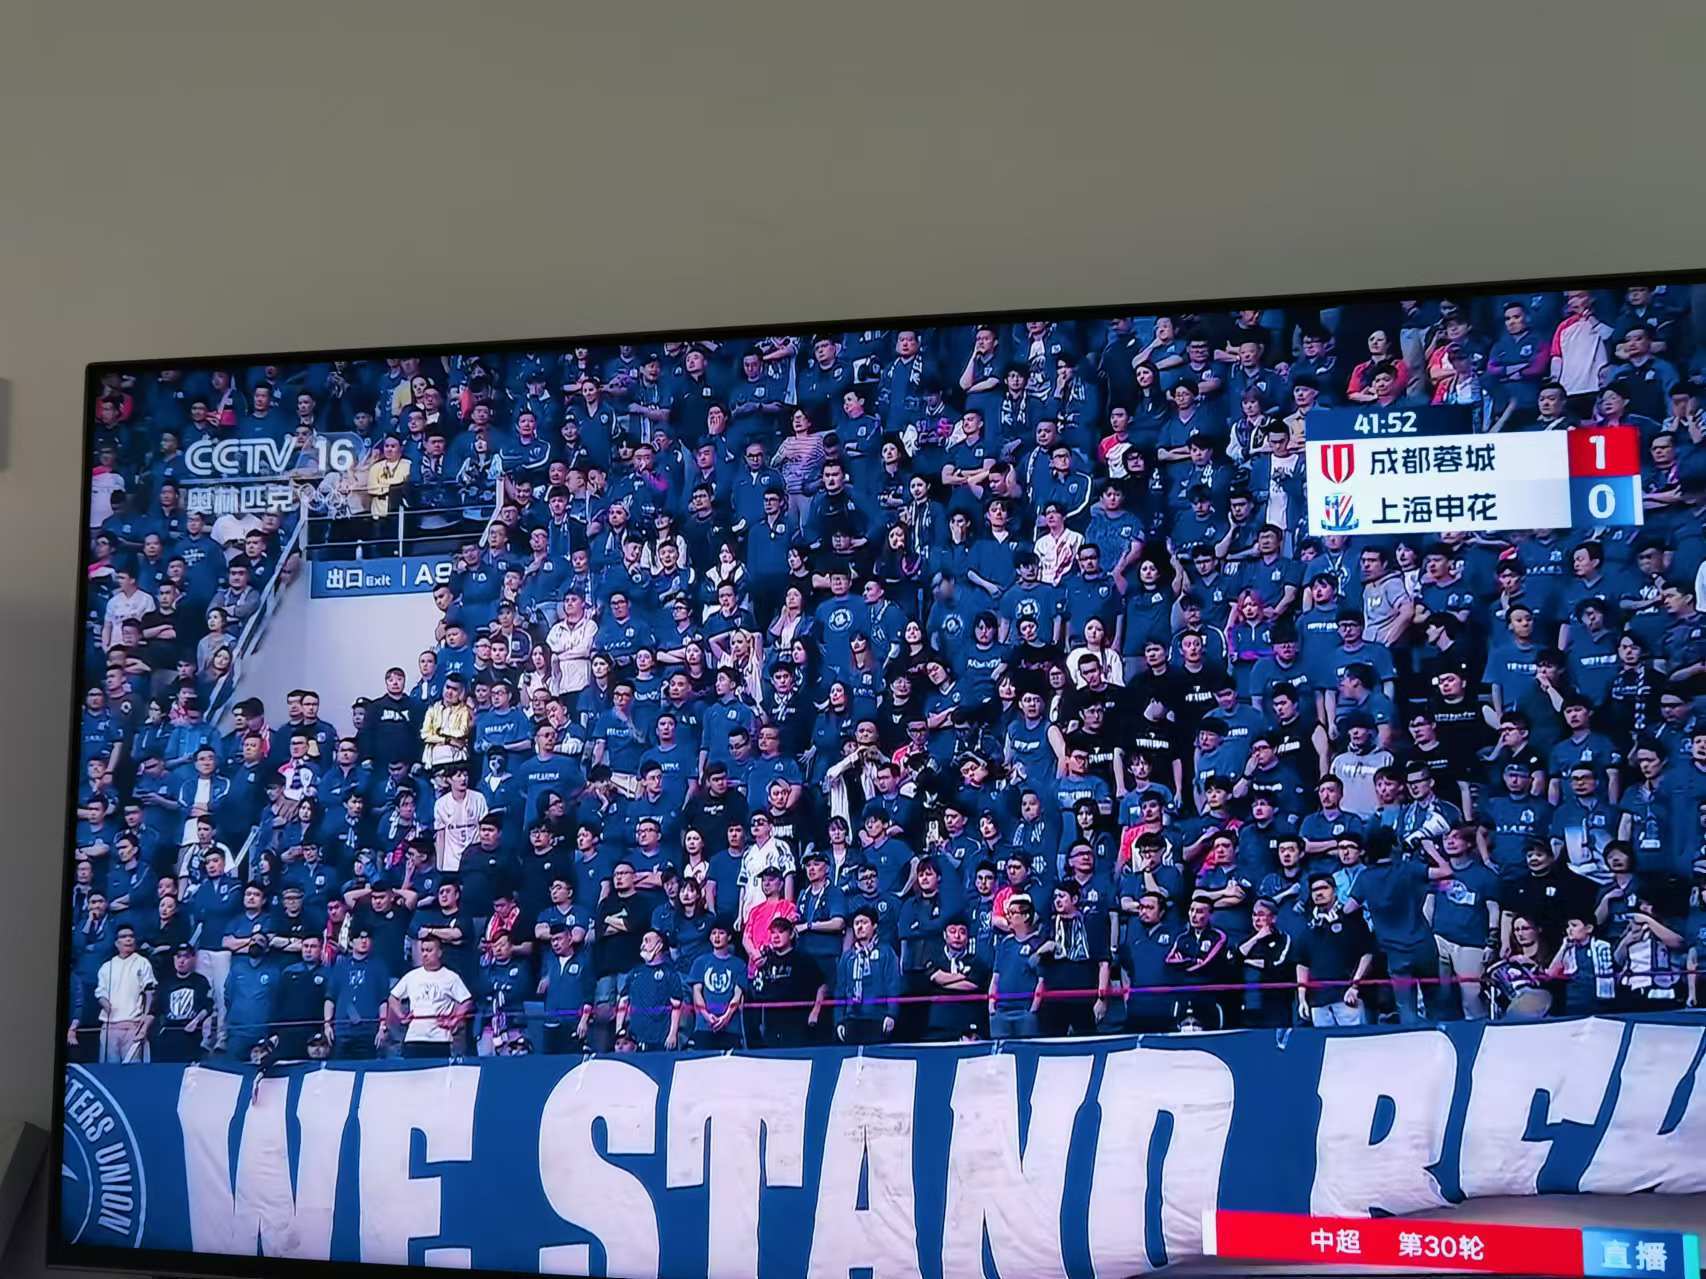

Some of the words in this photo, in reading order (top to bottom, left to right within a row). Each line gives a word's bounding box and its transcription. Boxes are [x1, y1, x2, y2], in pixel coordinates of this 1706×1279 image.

[1354, 411, 1417, 434] 41:52
[184, 433, 296, 475] CCTV
[314, 434, 354, 472] 16
[1369, 443, 1495, 475] 成都蓉城
[1589, 435, 1606, 470] 1
[187, 485, 299, 515] 奥林匹克
[1371, 493, 1498, 524] 上海申花
[1588, 483, 1616, 519] 0
[326, 568, 363, 589] 出口
[366, 575, 391, 587] Exit
[64, 1075, 115, 1142] TERS
[95, 1141, 134, 1236] UNION
[177, 1065, 481, 1270] WE
[538, 1048, 1235, 1279] STAND
[1310, 1228, 1361, 1256] 中超
[1399, 1231, 1485, 1262] 第30轮
[1601, 1240, 1670, 1272] 直播
